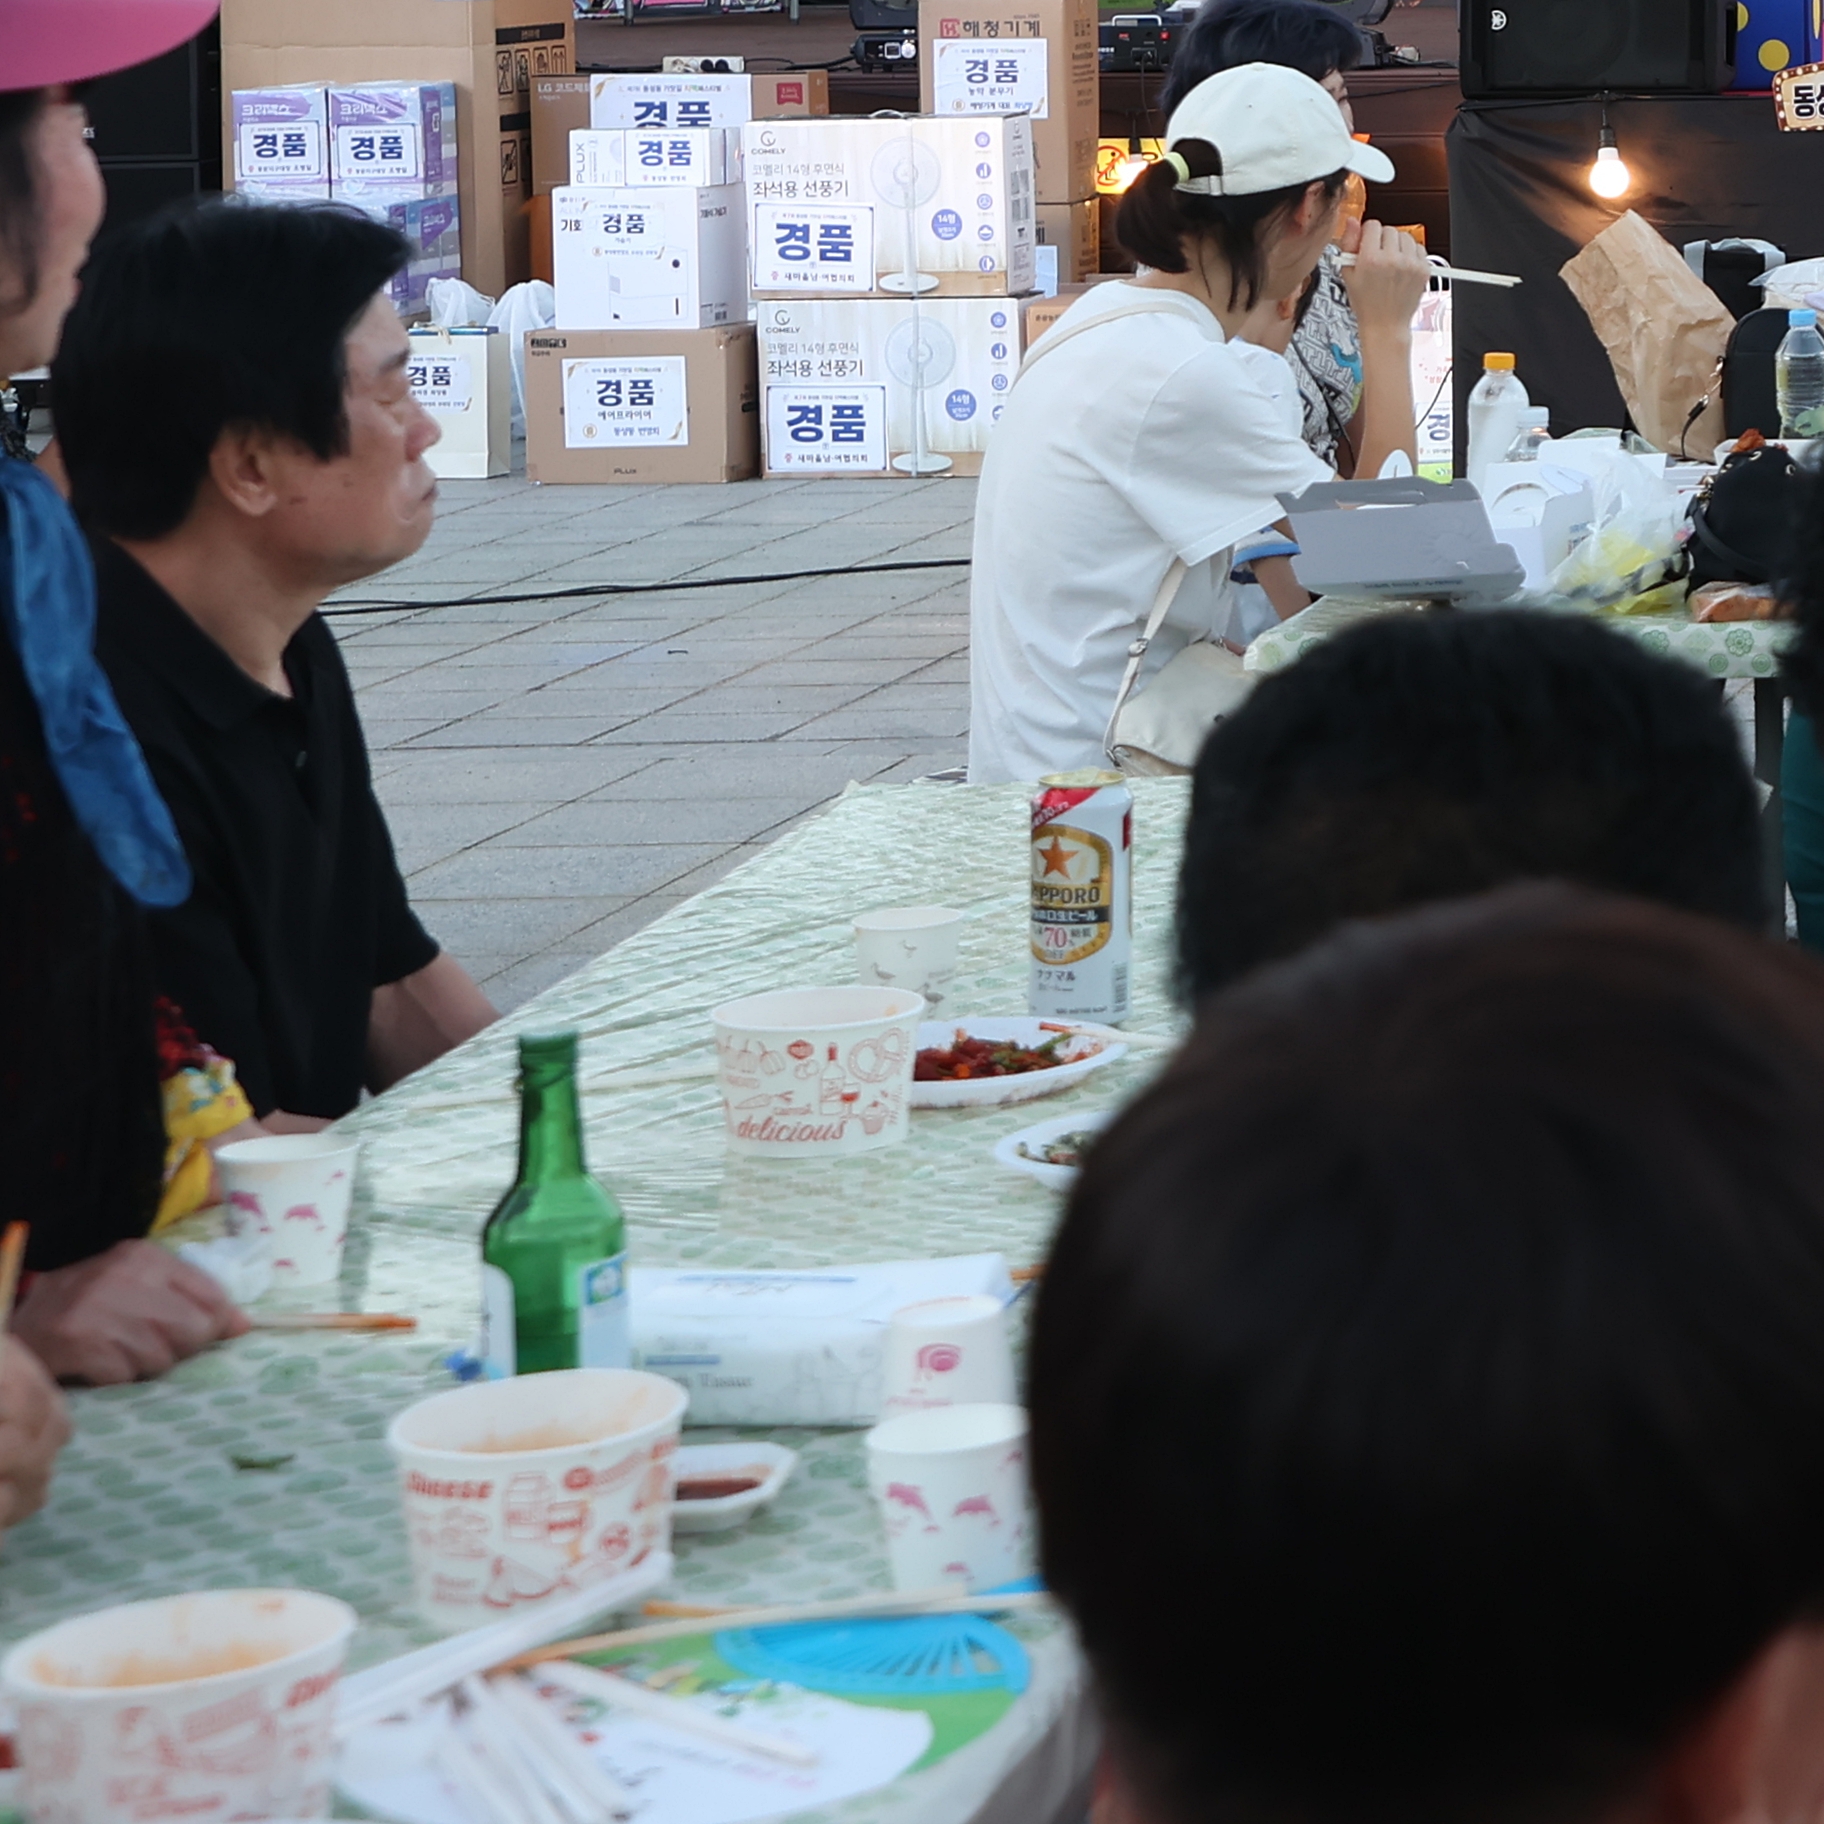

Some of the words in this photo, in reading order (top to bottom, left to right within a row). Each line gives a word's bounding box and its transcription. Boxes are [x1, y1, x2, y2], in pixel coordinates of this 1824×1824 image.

[963, 20, 1040, 38] 해청기계
[965, 59, 1019, 84] 경품
[537, 83, 552, 92] LG
[634, 100, 712, 128] 경품
[253, 133, 307, 159] 경품
[350, 136, 404, 161] 경품
[638, 140, 692, 167] 경품
[753, 180, 798, 198] 좌석용
[803, 180, 849, 198] 선풍기
[603, 213, 645, 234] 경품
[775, 222, 853, 262] 경품
[408, 366, 451, 386] 경품
[767, 360, 813, 377] 좌석용
[817, 360, 864, 377] 선풍기
[597, 379, 654, 407] 경품
[787, 404, 866, 443] 경품
[1429, 414, 1451, 441] 경
[737, 1116, 848, 1142] delicious
